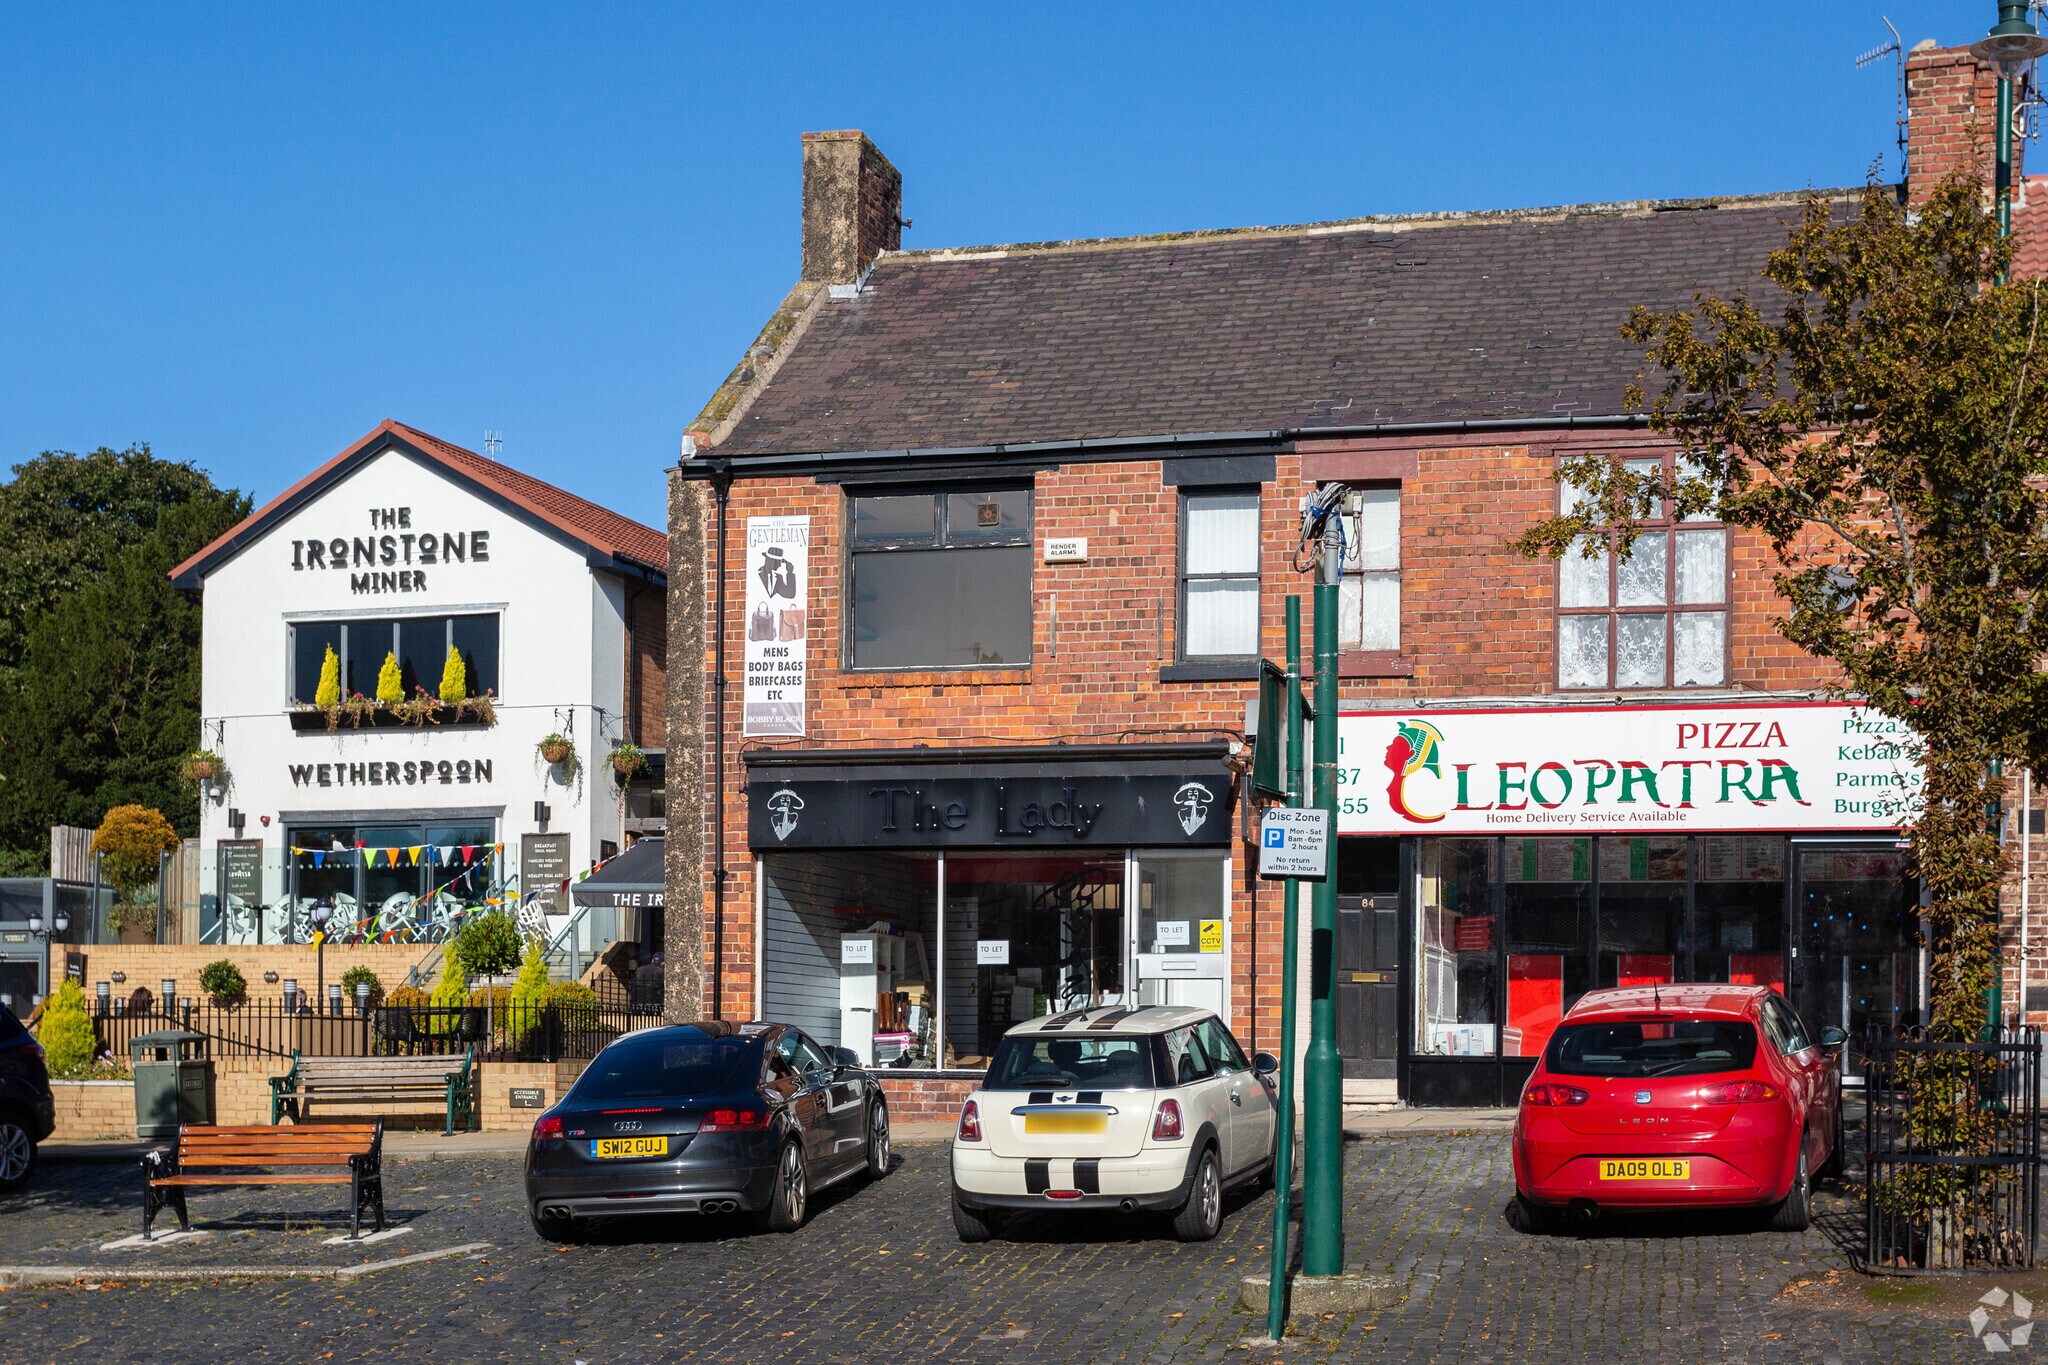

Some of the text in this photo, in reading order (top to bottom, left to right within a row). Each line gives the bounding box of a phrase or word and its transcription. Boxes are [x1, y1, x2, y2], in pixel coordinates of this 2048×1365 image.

[369, 506, 411, 530] THE
[749, 527, 808, 548] GENTLEMAN
[291, 530, 490, 571] IRONSTONE
[351, 570, 427, 595] MINER
[763, 647, 789, 658] MENS
[748, 661, 803, 672] BODY BAGS
[748, 675, 802, 687] BRIEFCASES
[767, 690, 783, 700] ETC
[775, 715, 802, 723] BLACK
[1675, 721, 1789, 750] PIZZA
[288, 758, 493, 789] WETHERSPOON
[1835, 771, 1920, 787] Parmo's
[868, 786, 1104, 840] The Lady
[1269, 811, 1321, 823] Disc Zone
[1486, 810, 1687, 825] Home Delivery Service Available
[1268, 830, 1280, 846] P
[1309, 828, 1322, 836] Sat
[613, 893, 641, 906] THE
[1361, 898, 1375, 908] 84
[1160, 926, 1184, 934] TO LET
[1200, 937, 1221, 945] CCTV
[980, 945, 1003, 953] TO LET
[603, 1138, 662, 1155] SW12 GUJ
[1606, 1162, 1683, 1177] DA09 OLB
